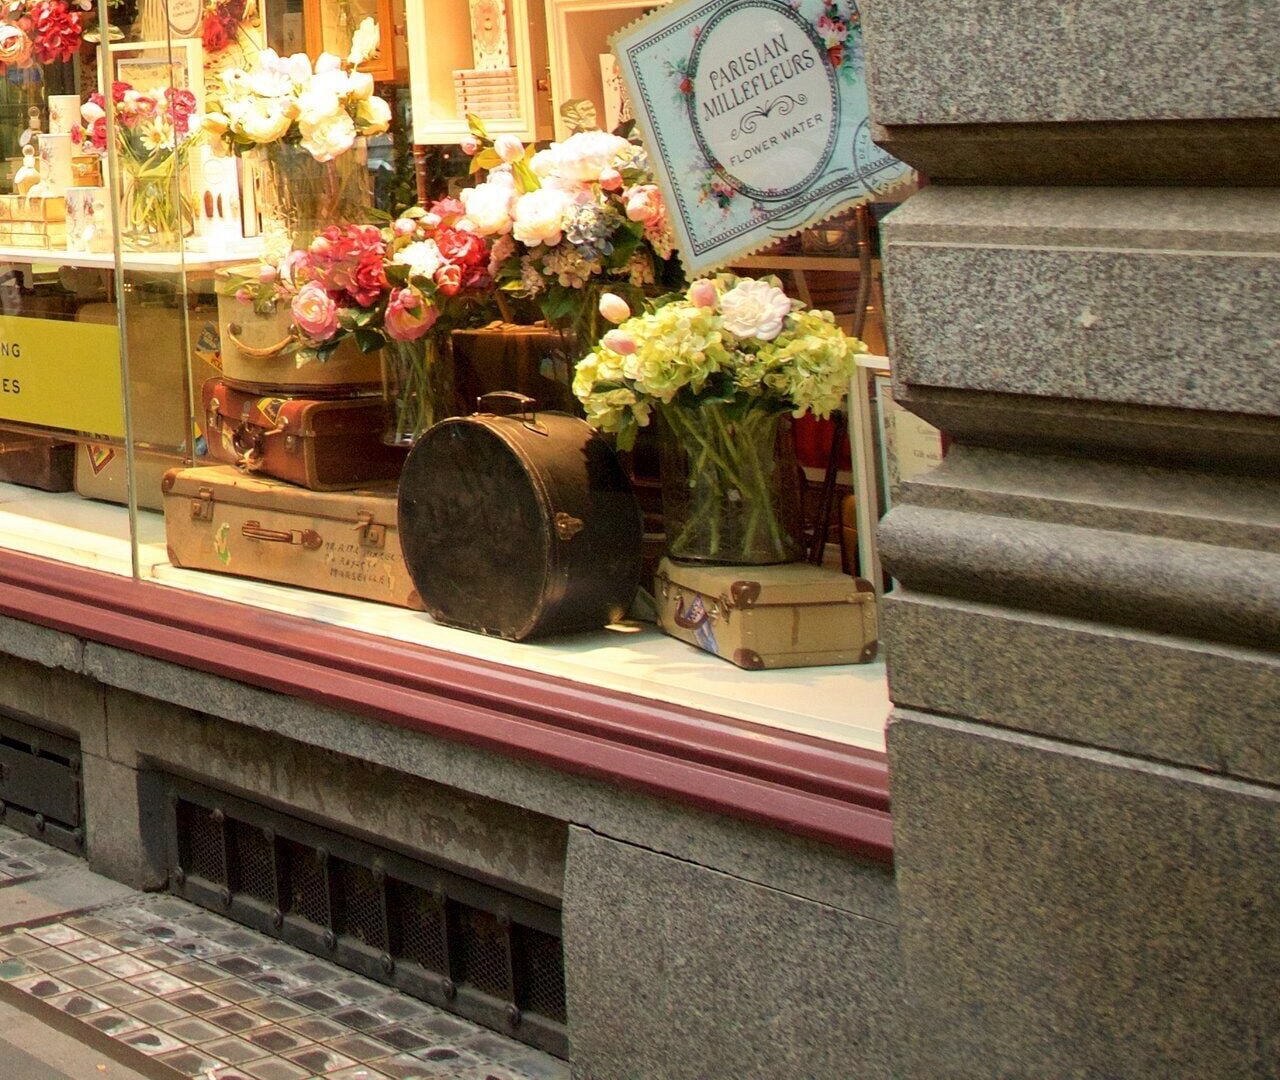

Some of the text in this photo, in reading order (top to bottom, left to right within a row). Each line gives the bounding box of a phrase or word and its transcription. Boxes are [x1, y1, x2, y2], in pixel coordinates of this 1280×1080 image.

[702, 49, 816, 122] MILLEFLEURS
[709, 33, 789, 91] PARISIAN
[729, 113, 824, 167] FLOWER WATER
